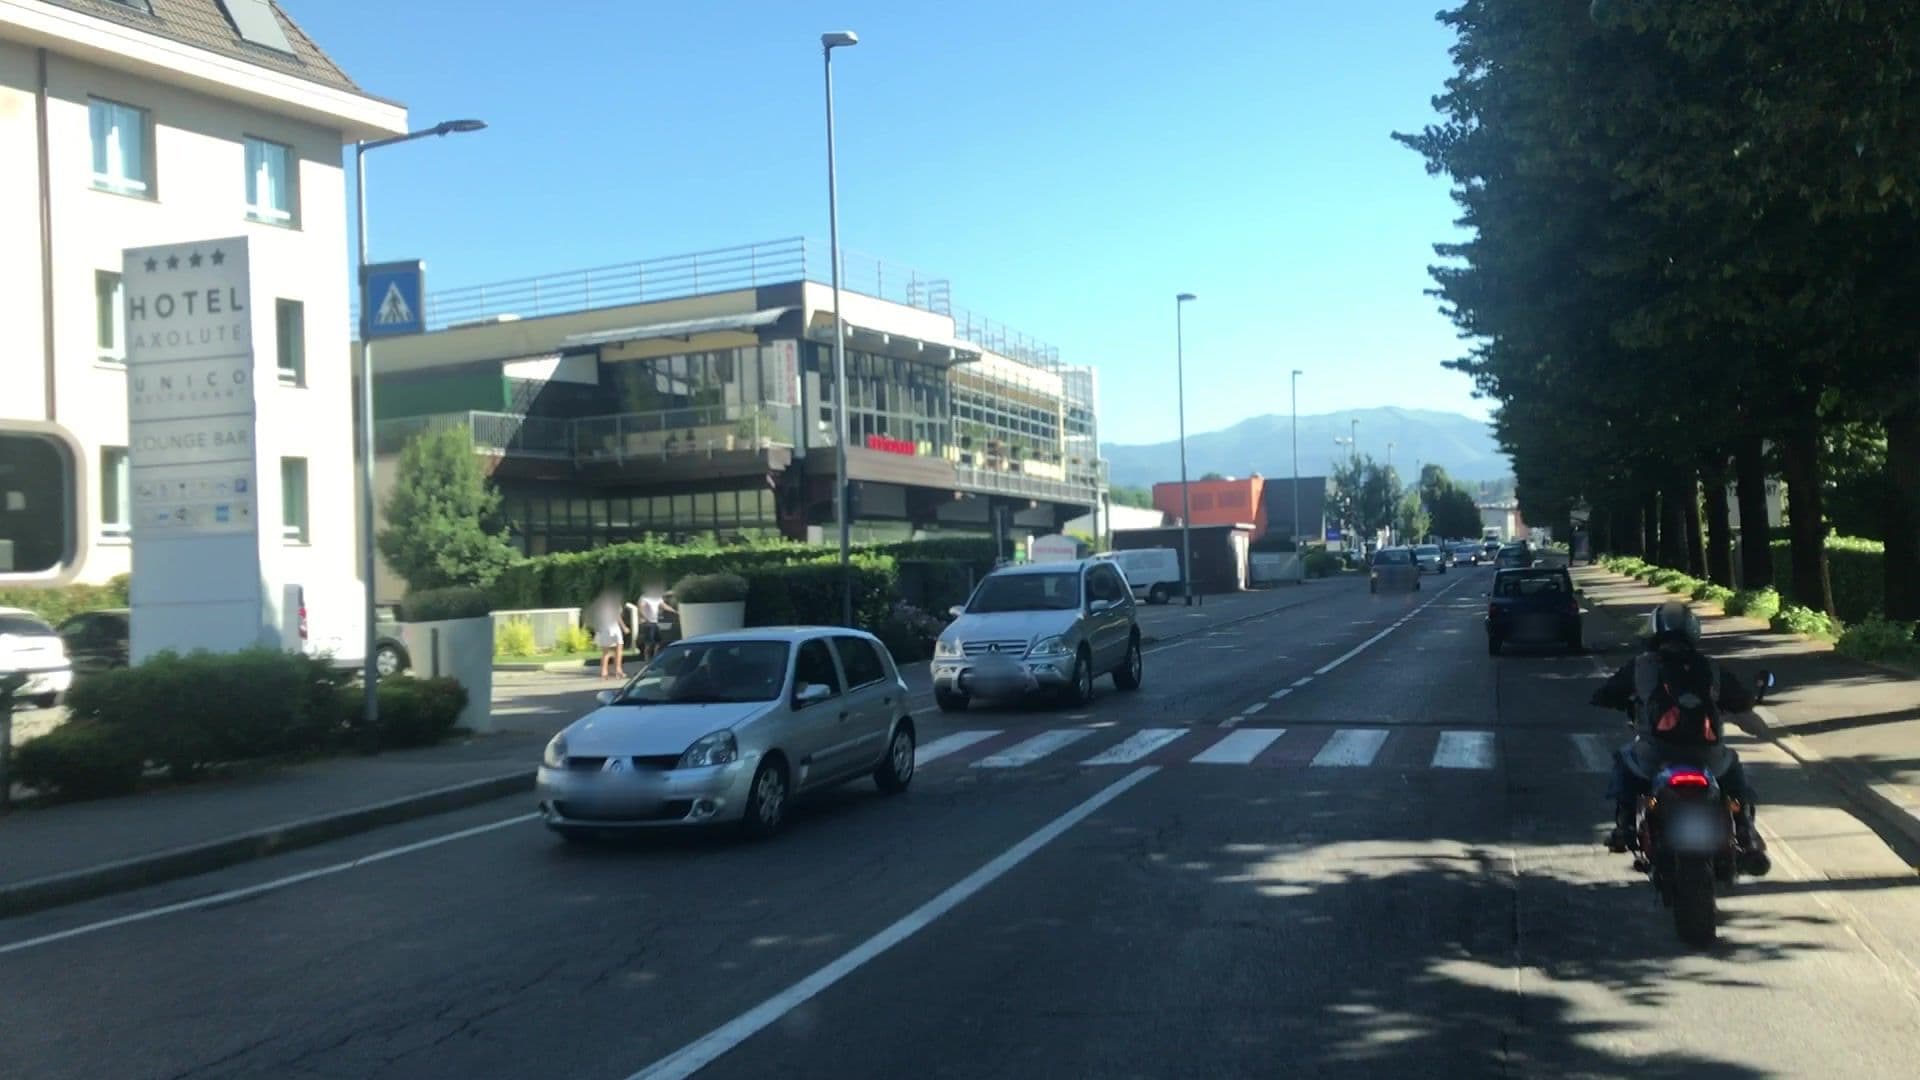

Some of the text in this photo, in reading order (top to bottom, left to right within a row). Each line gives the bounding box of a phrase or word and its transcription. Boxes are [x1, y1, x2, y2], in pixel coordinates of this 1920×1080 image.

[129, 287, 244, 321] HOTEL
[135, 323, 242, 349] AXOLUTE
[134, 368, 247, 393] UNICO
[133, 429, 248, 453] LOUNGE BAR
